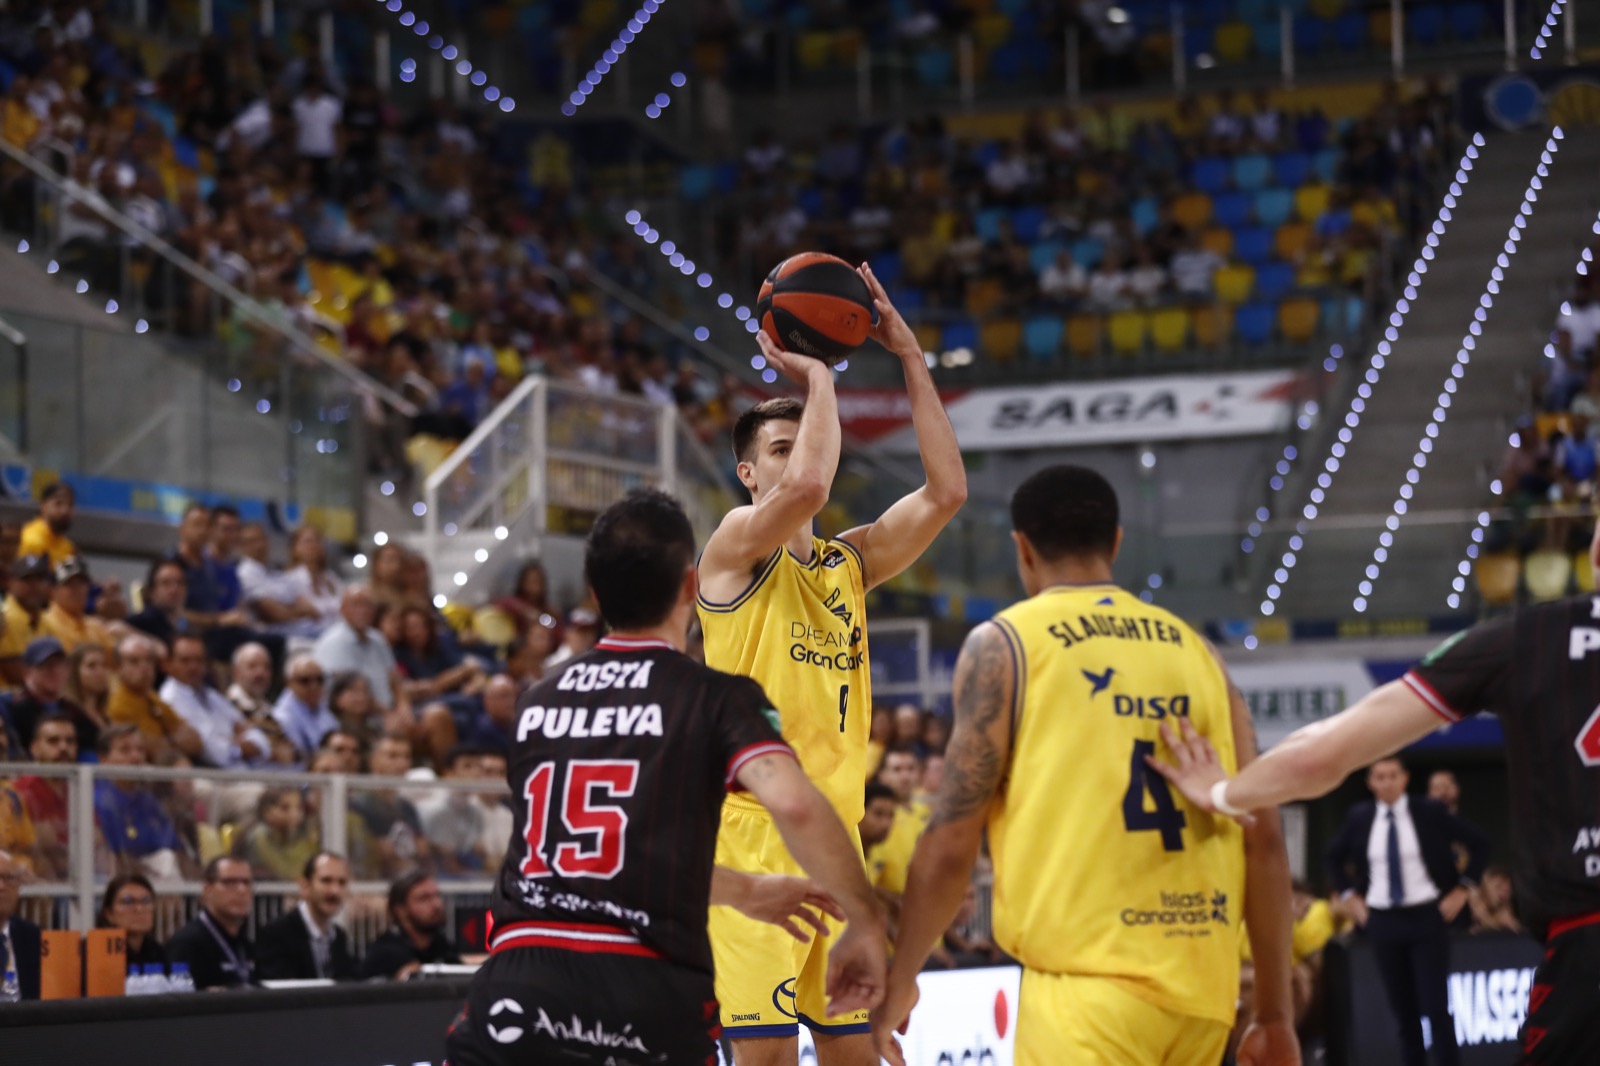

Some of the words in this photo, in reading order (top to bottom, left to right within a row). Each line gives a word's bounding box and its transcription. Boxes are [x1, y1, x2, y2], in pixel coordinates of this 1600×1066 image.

[992, 390, 1179, 431] SAGA
[1048, 613, 1184, 648] SLAUGHTER
[790, 643, 833, 670] Gran
[557, 660, 655, 692] COSTA
[516, 703, 664, 742] PULEVA
[839, 684, 849, 733] 9
[1122, 738, 1186, 852] 4
[519, 758, 641, 880] 15
[1120, 908, 1209, 926] Canarias
[1160, 890, 1206, 908] Islas
[534, 1007, 650, 1054] Andalucía
[731, 1012, 761, 1023] SPALDING
